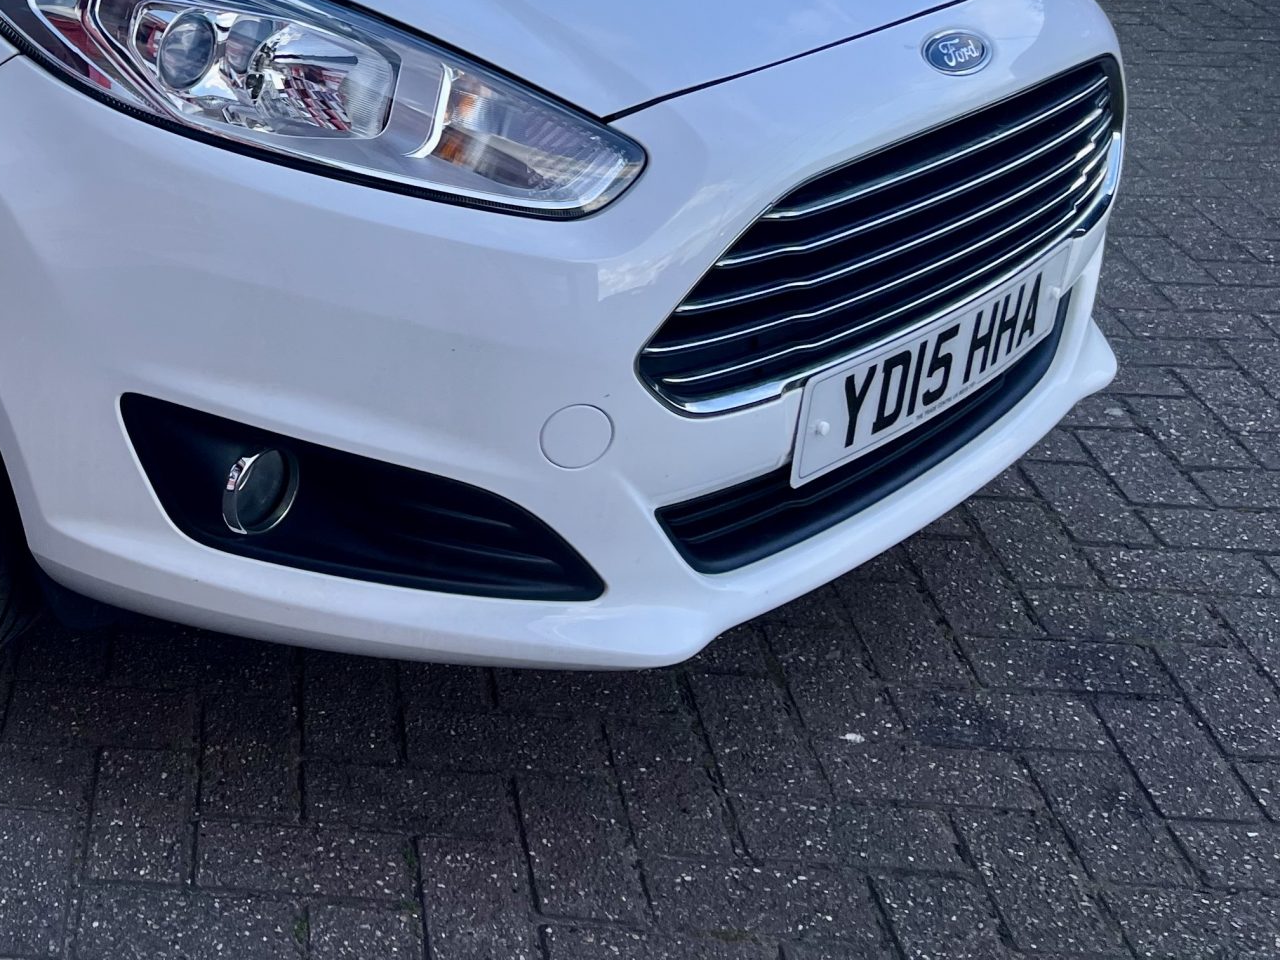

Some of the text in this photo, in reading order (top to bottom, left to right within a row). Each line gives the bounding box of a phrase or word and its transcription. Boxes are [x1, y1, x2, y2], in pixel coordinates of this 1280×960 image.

[938, 38, 980, 67] Ford
[844, 272, 1043, 448] YD15 HHA
